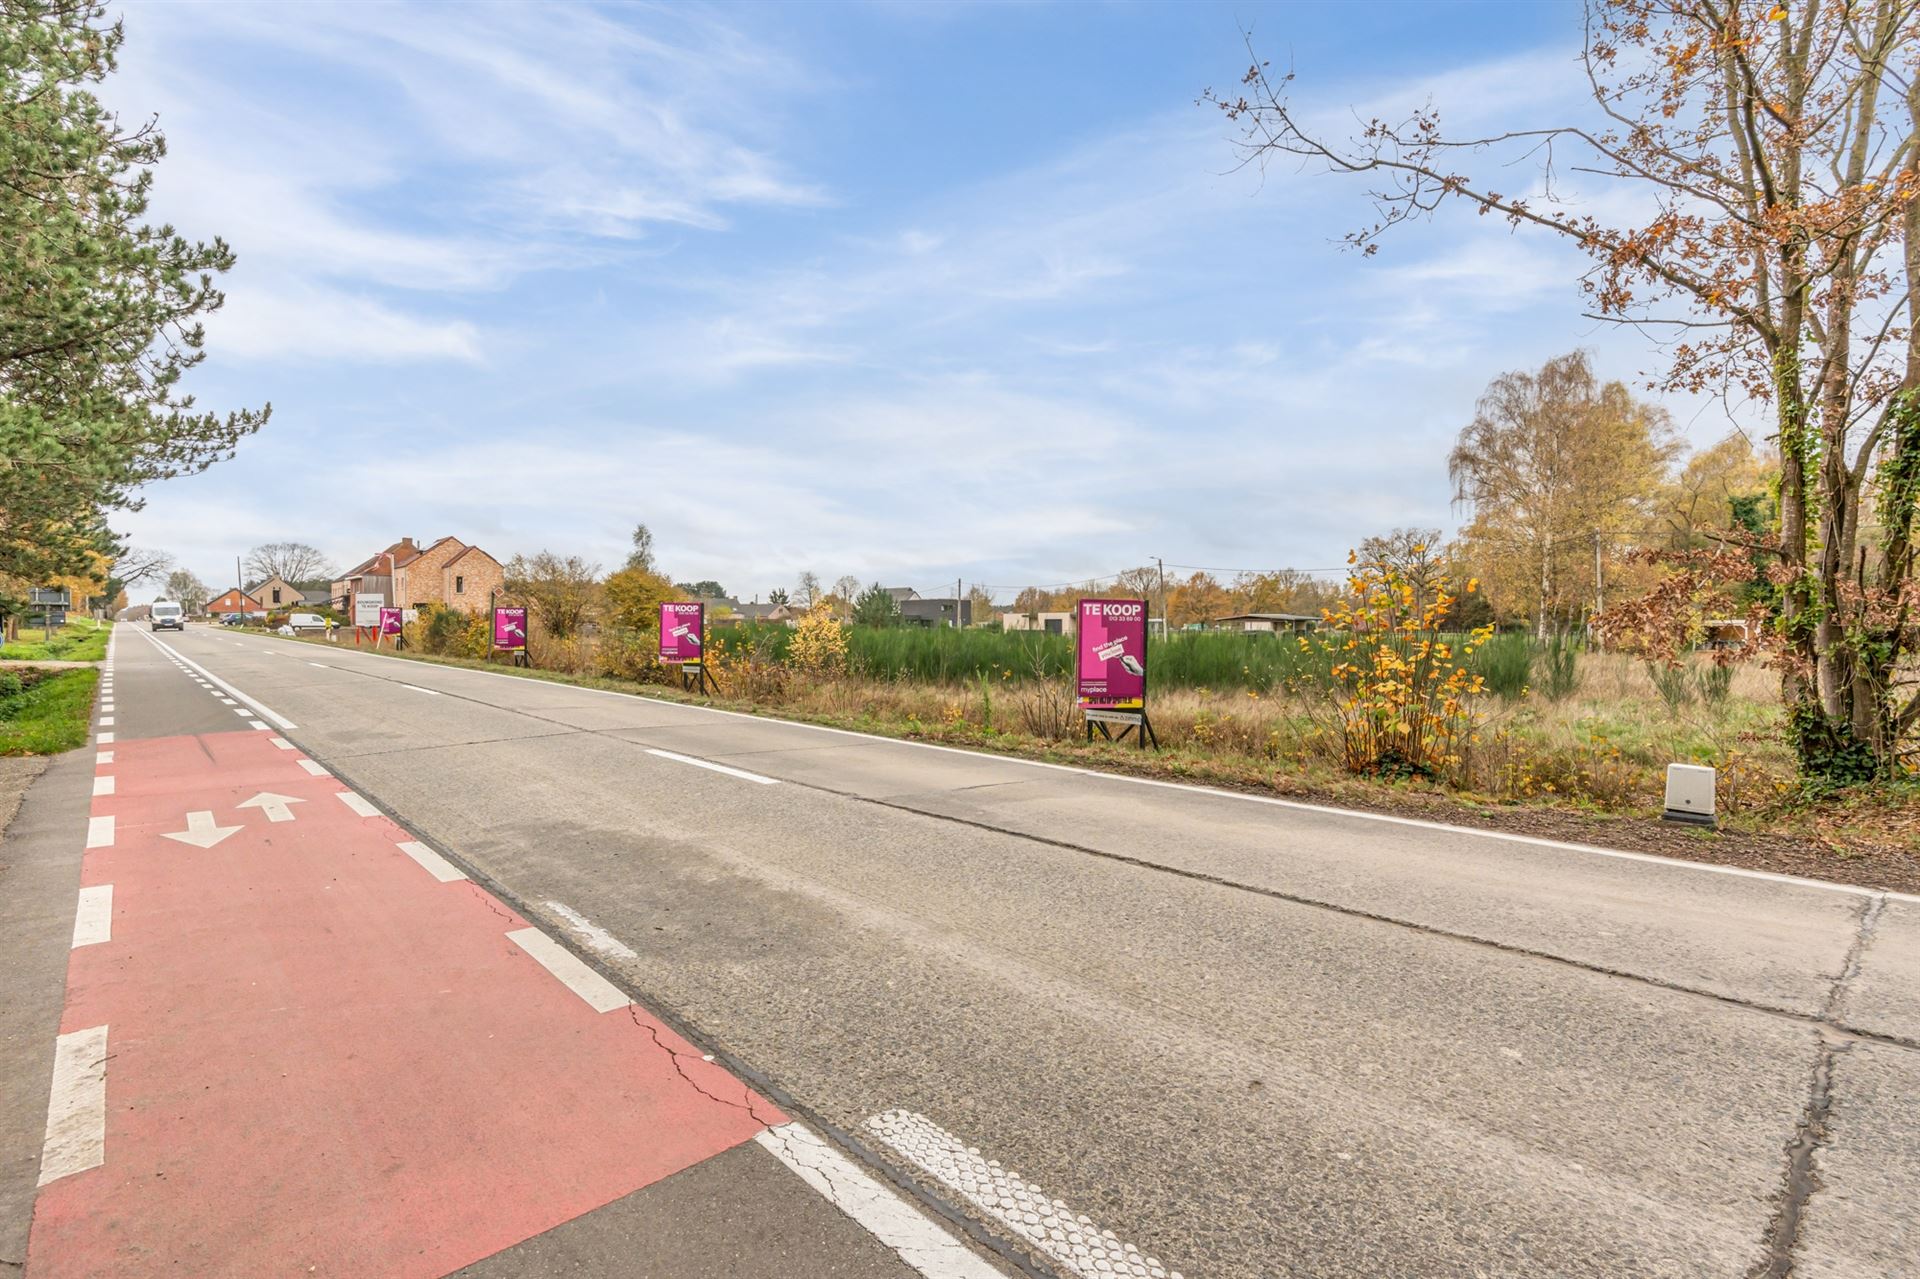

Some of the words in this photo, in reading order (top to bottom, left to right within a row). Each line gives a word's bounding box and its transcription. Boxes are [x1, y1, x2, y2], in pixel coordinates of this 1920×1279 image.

[663, 604, 674, 612] TE
[1083, 604, 1101, 616] TE
[1103, 604, 1141, 616] KOOP
[1103, 641, 1113, 649] the
[1113, 635, 1128, 647] place
